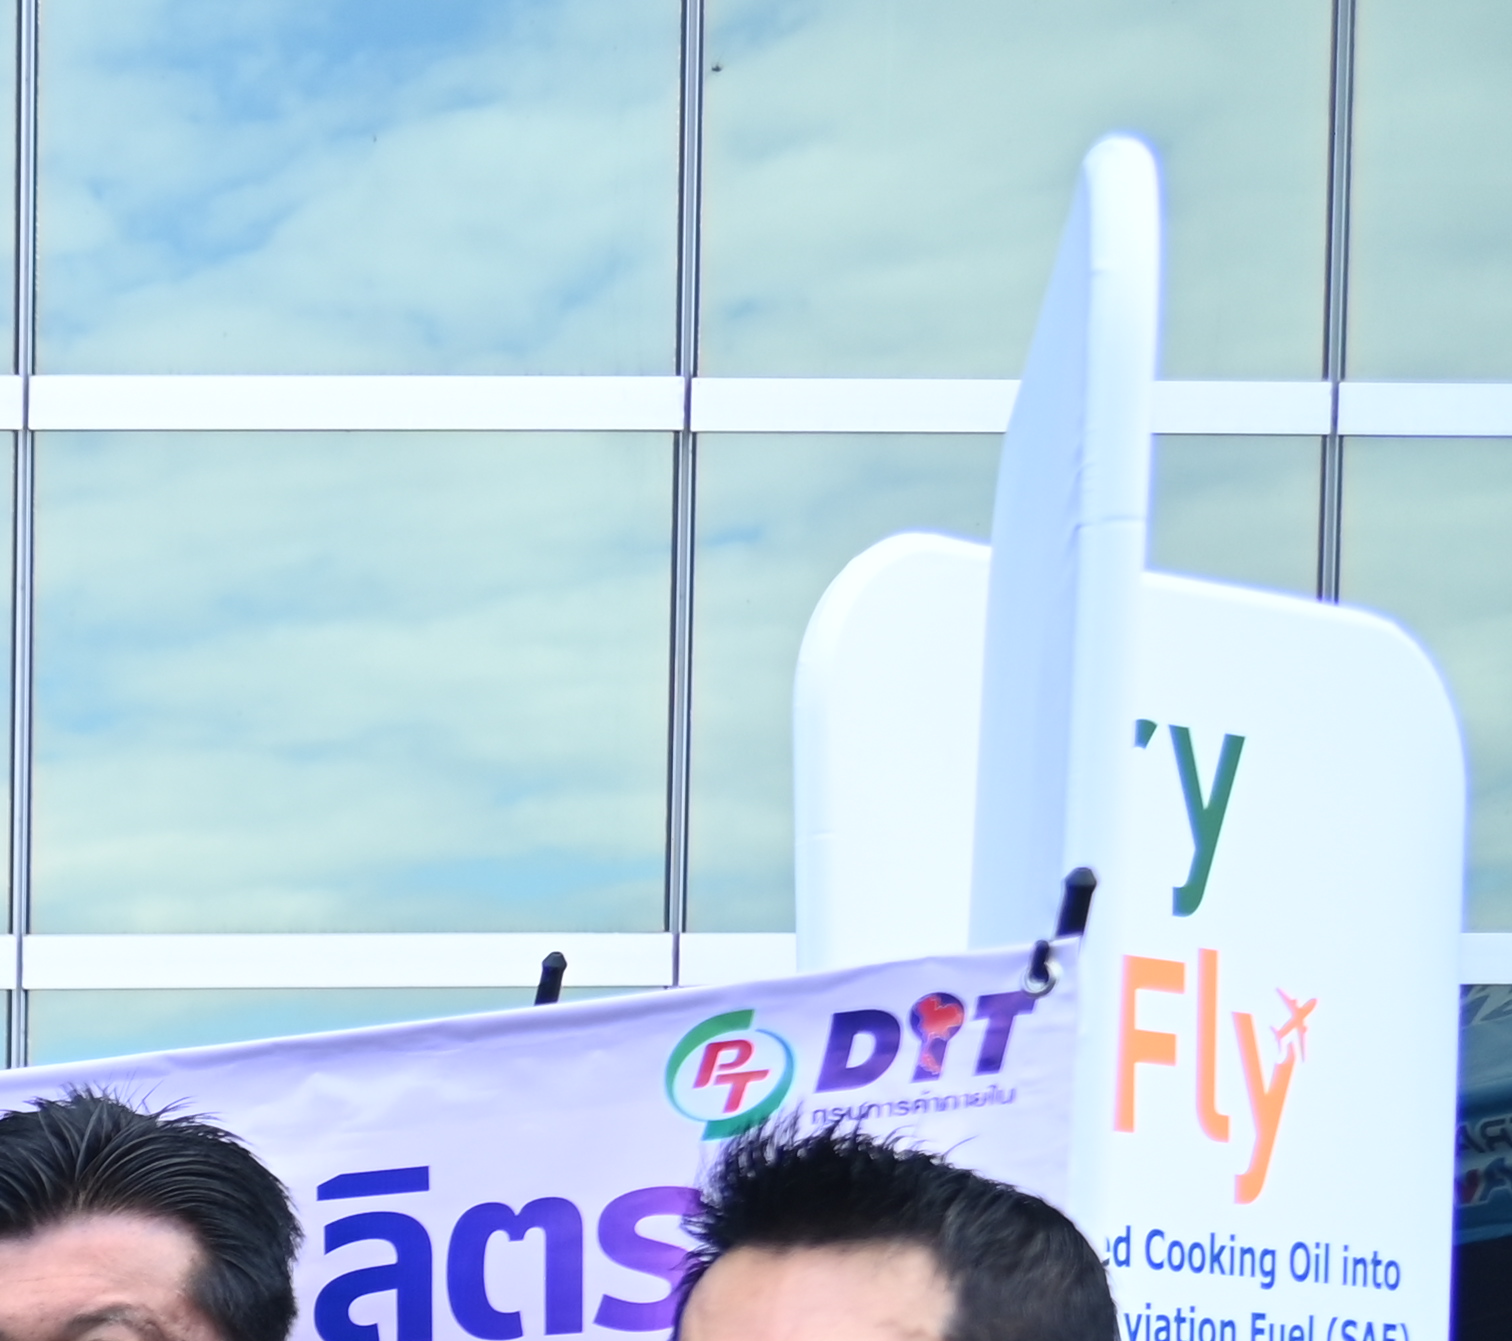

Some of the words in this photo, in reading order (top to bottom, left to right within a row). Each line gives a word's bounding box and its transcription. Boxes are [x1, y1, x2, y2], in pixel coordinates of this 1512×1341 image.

[693, 1039, 771, 1113] PT
[1114, 948, 1296, 1205] Fly
[1145, 1229, 1277, 1291] Cooking
[1289, 1241, 1330, 1284] Oil
[1342, 1245, 1401, 1292] into
